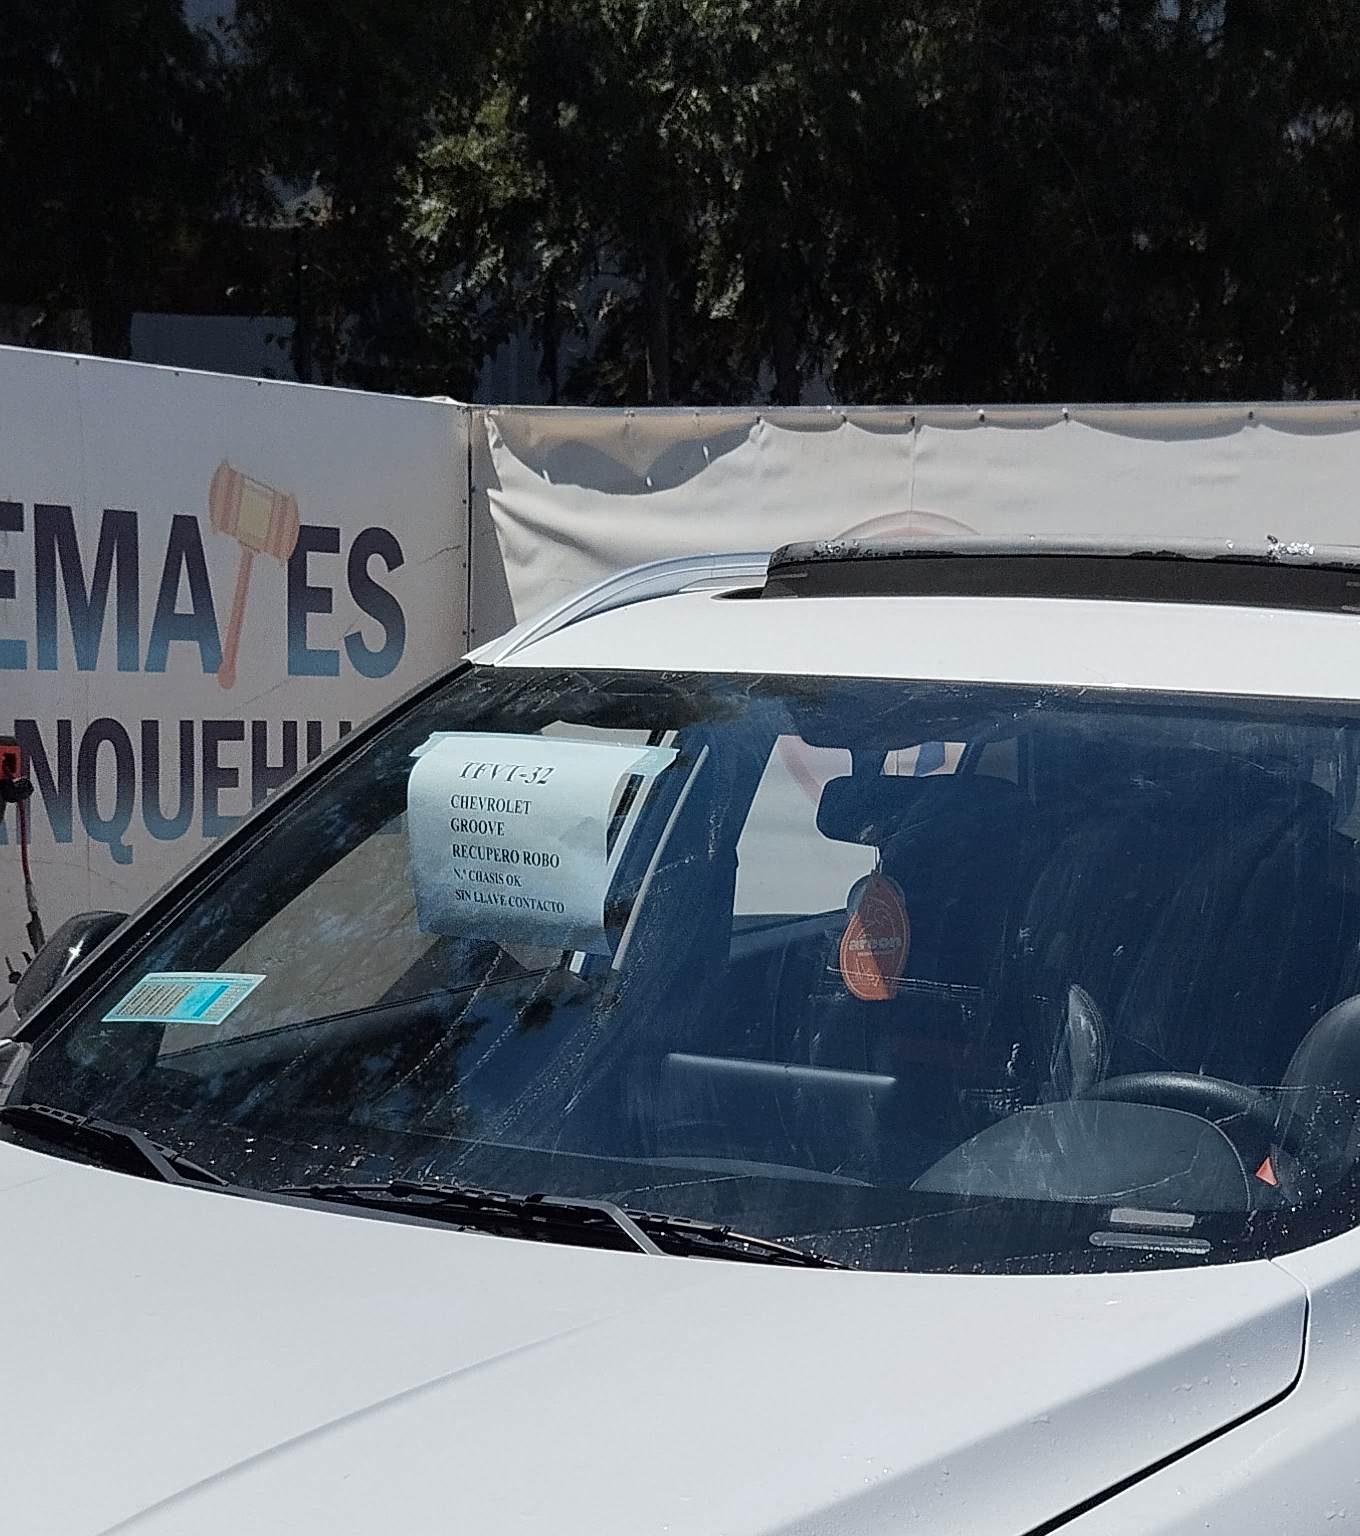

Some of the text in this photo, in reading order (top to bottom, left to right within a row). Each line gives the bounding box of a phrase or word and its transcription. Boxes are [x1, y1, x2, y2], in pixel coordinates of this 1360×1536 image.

[450, 794, 532, 815] CHEVROLET
[450, 817, 505, 836] GROOVE
[452, 843, 560, 868] RECUPERO ROBO
[468, 869, 504, 885] CHASIS
[506, 874, 522, 887] OK
[455, 888, 565, 913] SIN LLAVE CONTACTO
